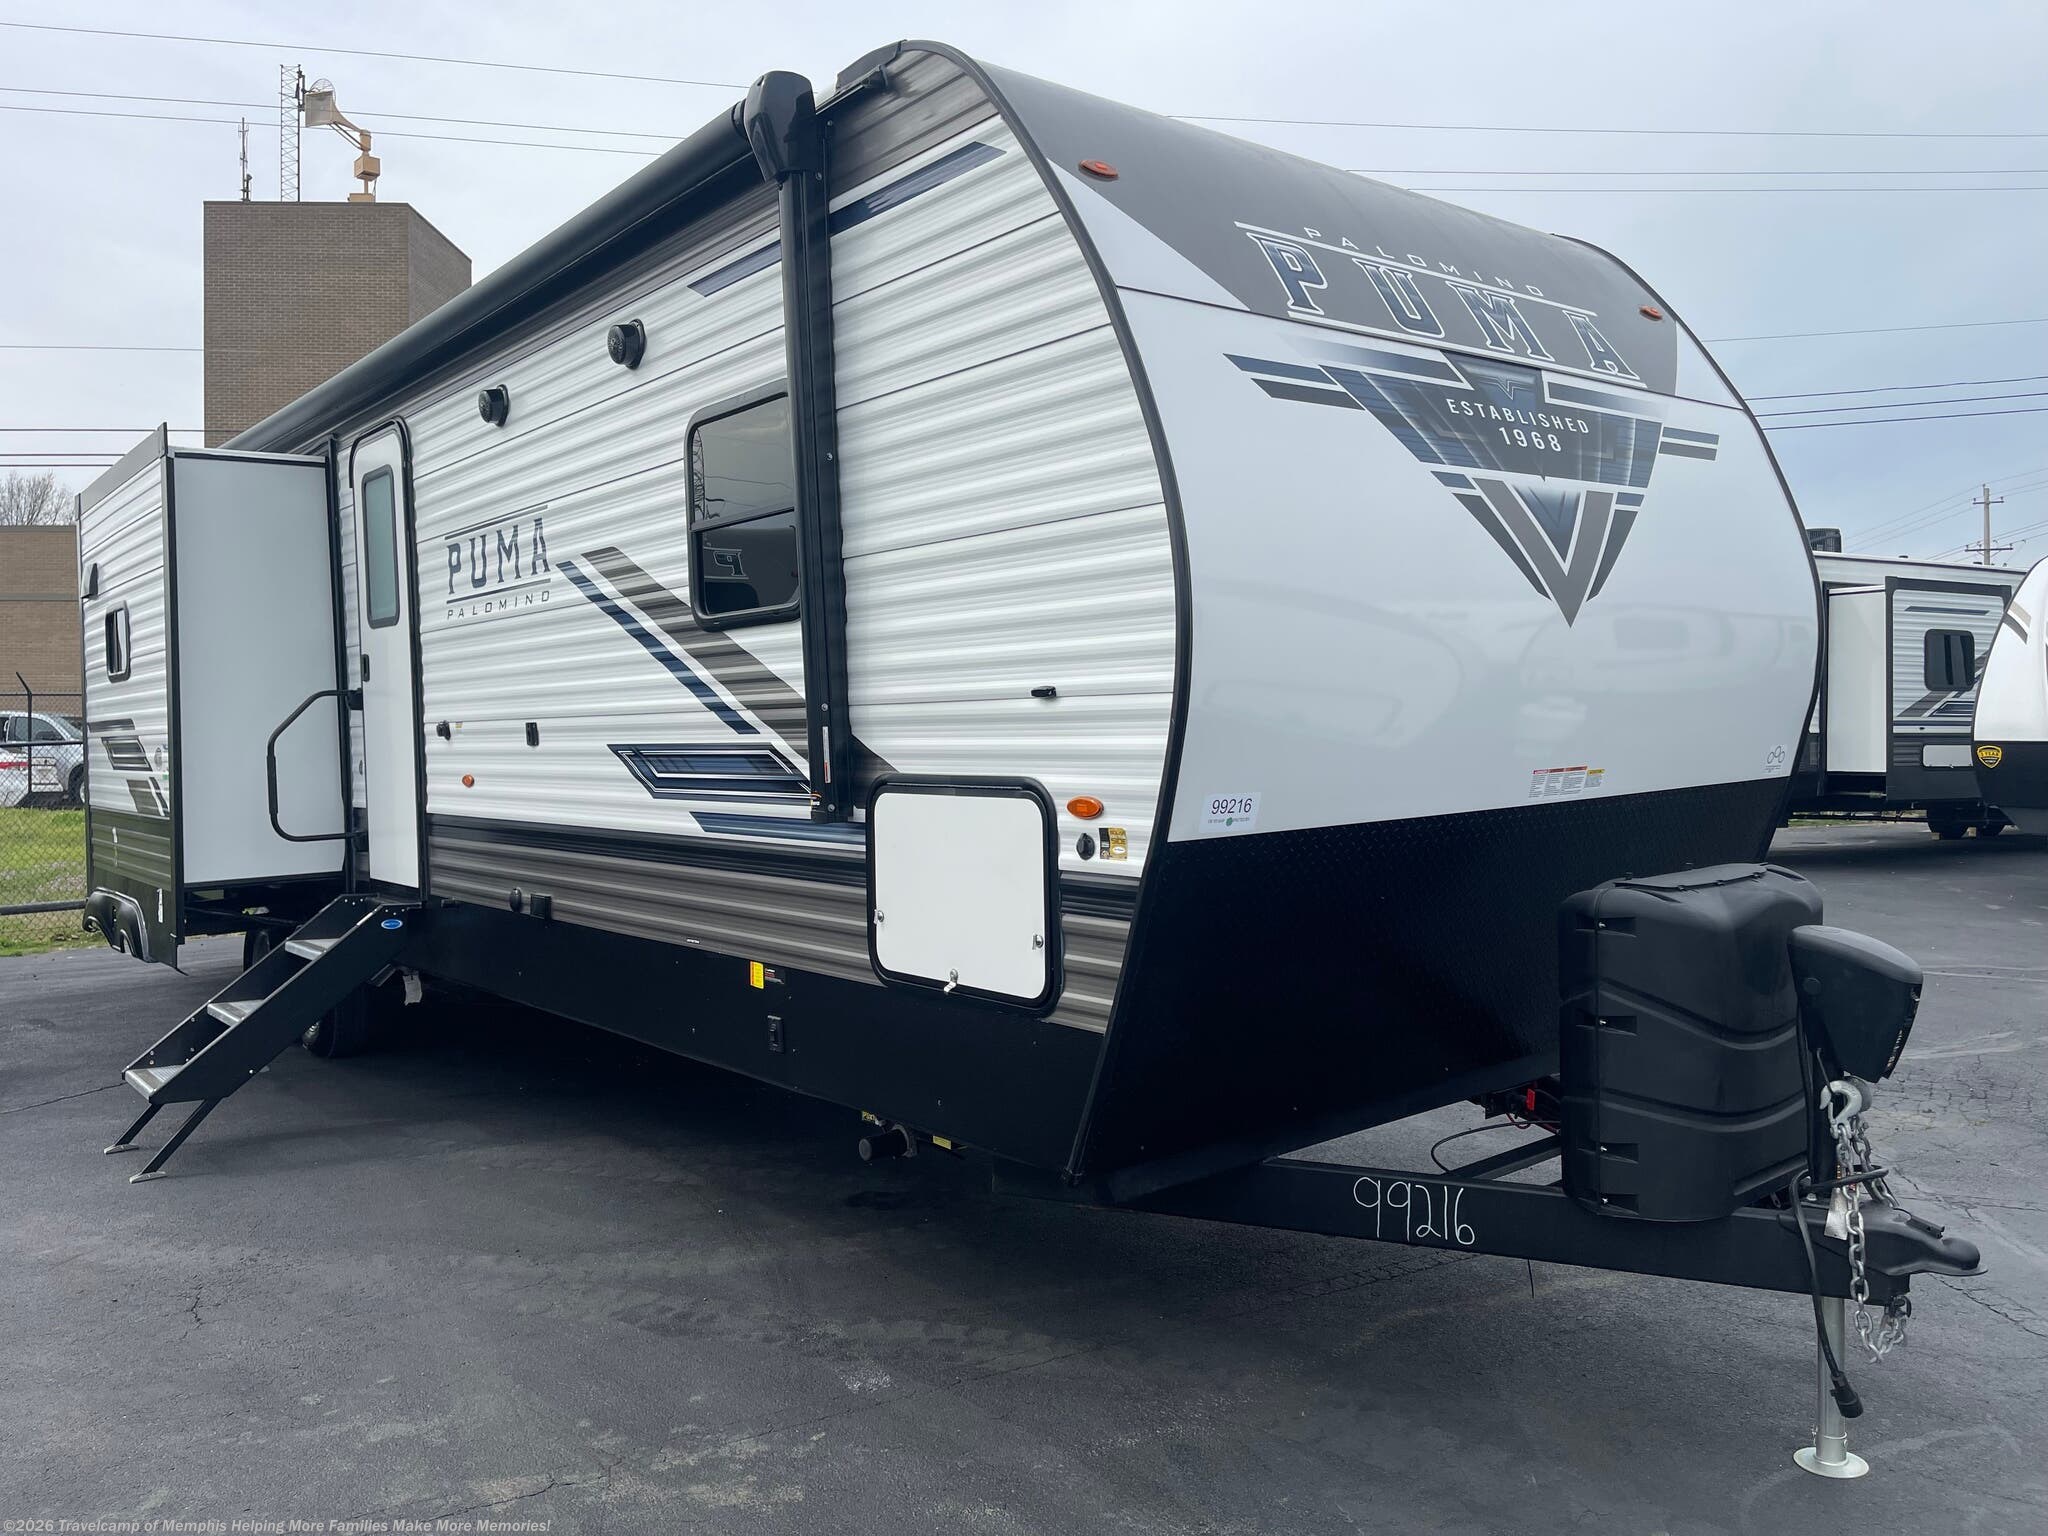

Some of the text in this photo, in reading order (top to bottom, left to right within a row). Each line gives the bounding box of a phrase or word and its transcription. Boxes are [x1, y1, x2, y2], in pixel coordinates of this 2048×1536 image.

[1304, 227, 1543, 296] PALOMINO
[1246, 232, 1641, 379] PUMA
[1446, 399, 1589, 433] ESTABLISHED
[1499, 427, 1561, 452] 1968
[447, 517, 550, 595] PUMA
[447, 590, 550, 620] PALOMINO
[1211, 798, 1253, 815] 99216
[1353, 1176, 1475, 1245] 99216
